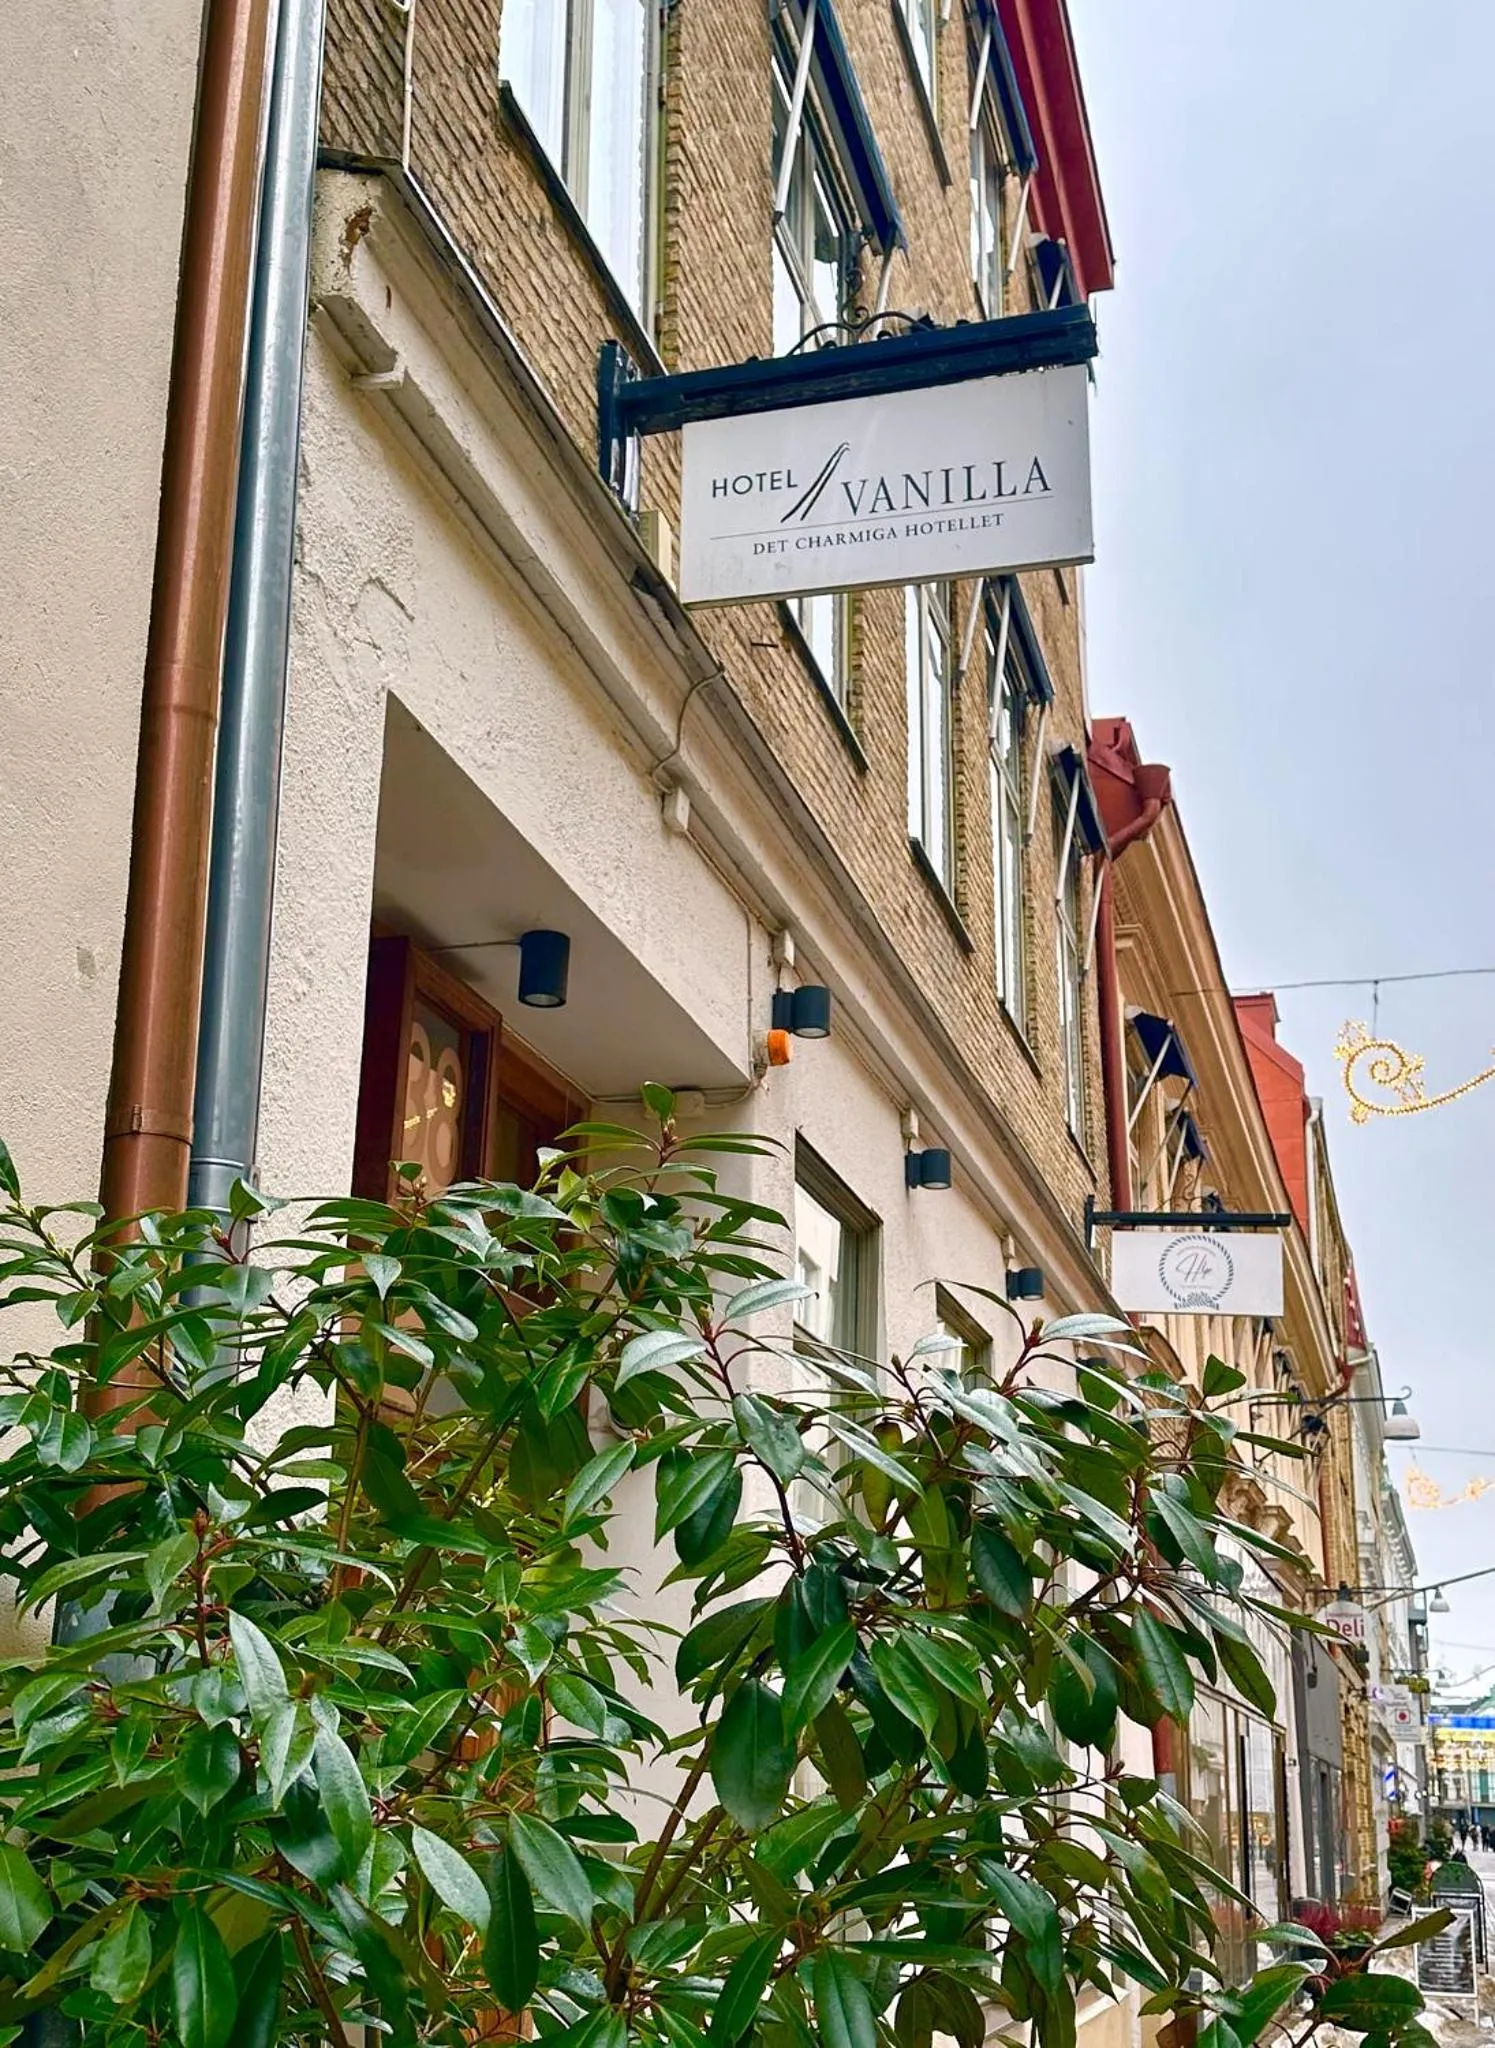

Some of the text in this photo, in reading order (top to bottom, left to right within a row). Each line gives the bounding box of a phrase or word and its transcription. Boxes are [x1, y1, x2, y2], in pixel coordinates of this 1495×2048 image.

[711, 456, 1052, 516] HOTEL VANILLA
[752, 512, 1005, 556] DET CHARMIGA HOTELLET
